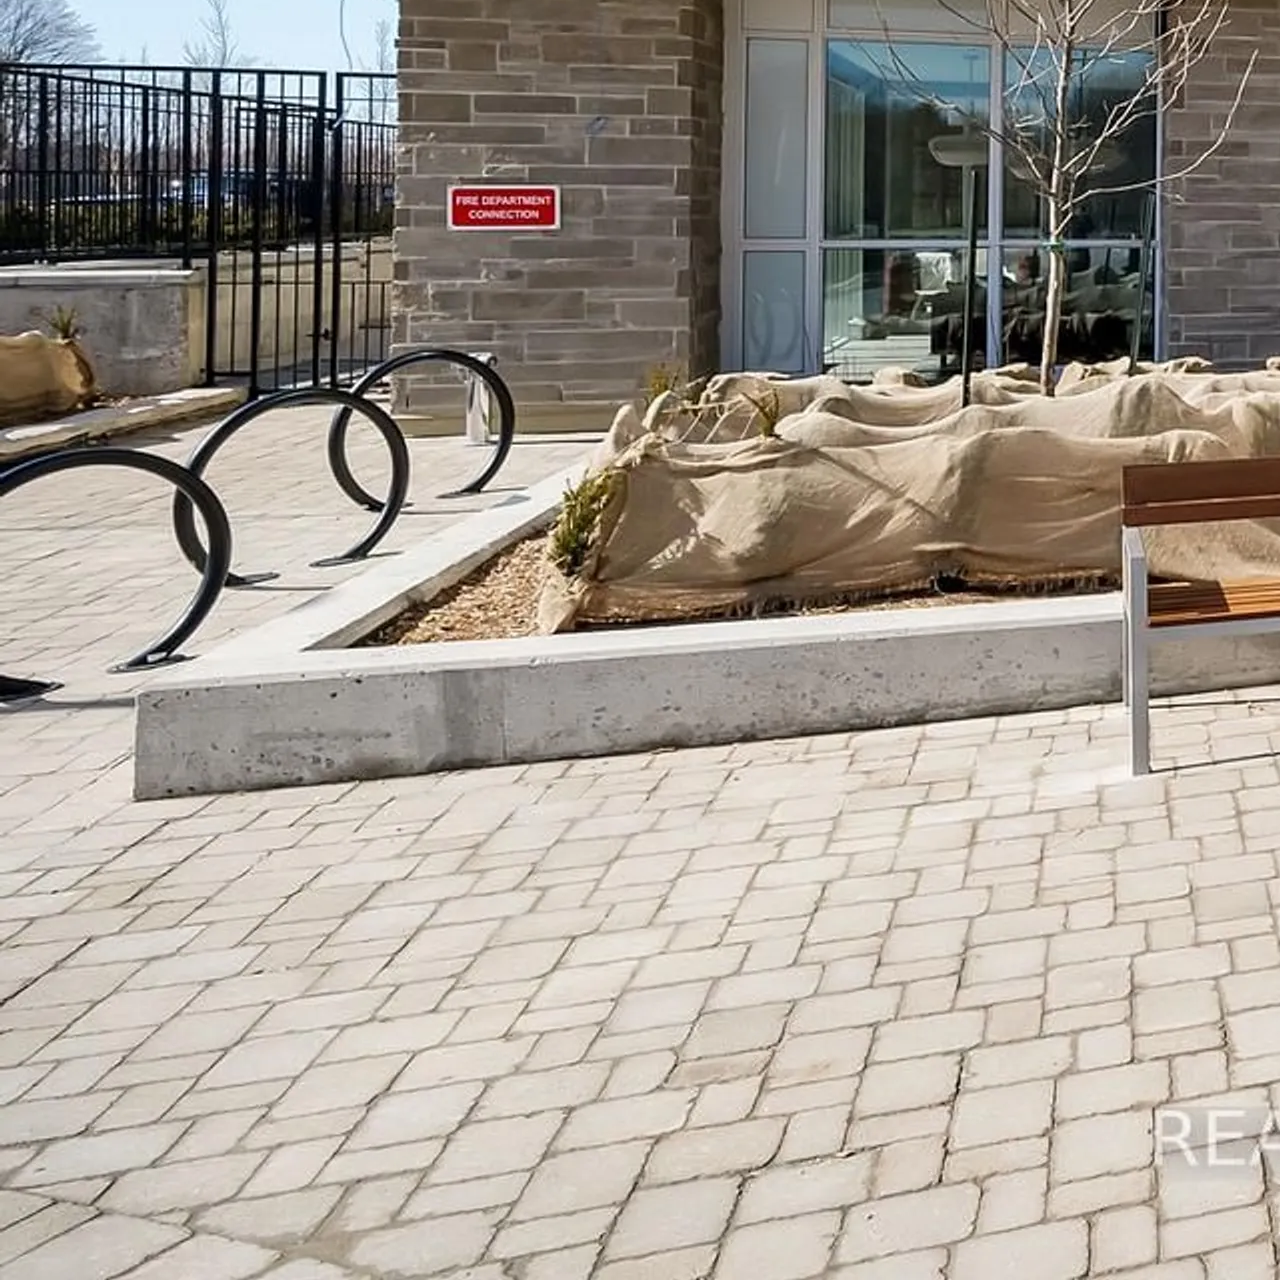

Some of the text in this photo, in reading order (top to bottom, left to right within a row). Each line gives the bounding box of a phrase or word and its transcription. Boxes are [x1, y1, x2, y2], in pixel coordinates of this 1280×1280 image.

[456, 195, 552, 206] FIRE DEPARTMENT
[468, 209, 540, 220] CONNECTION
